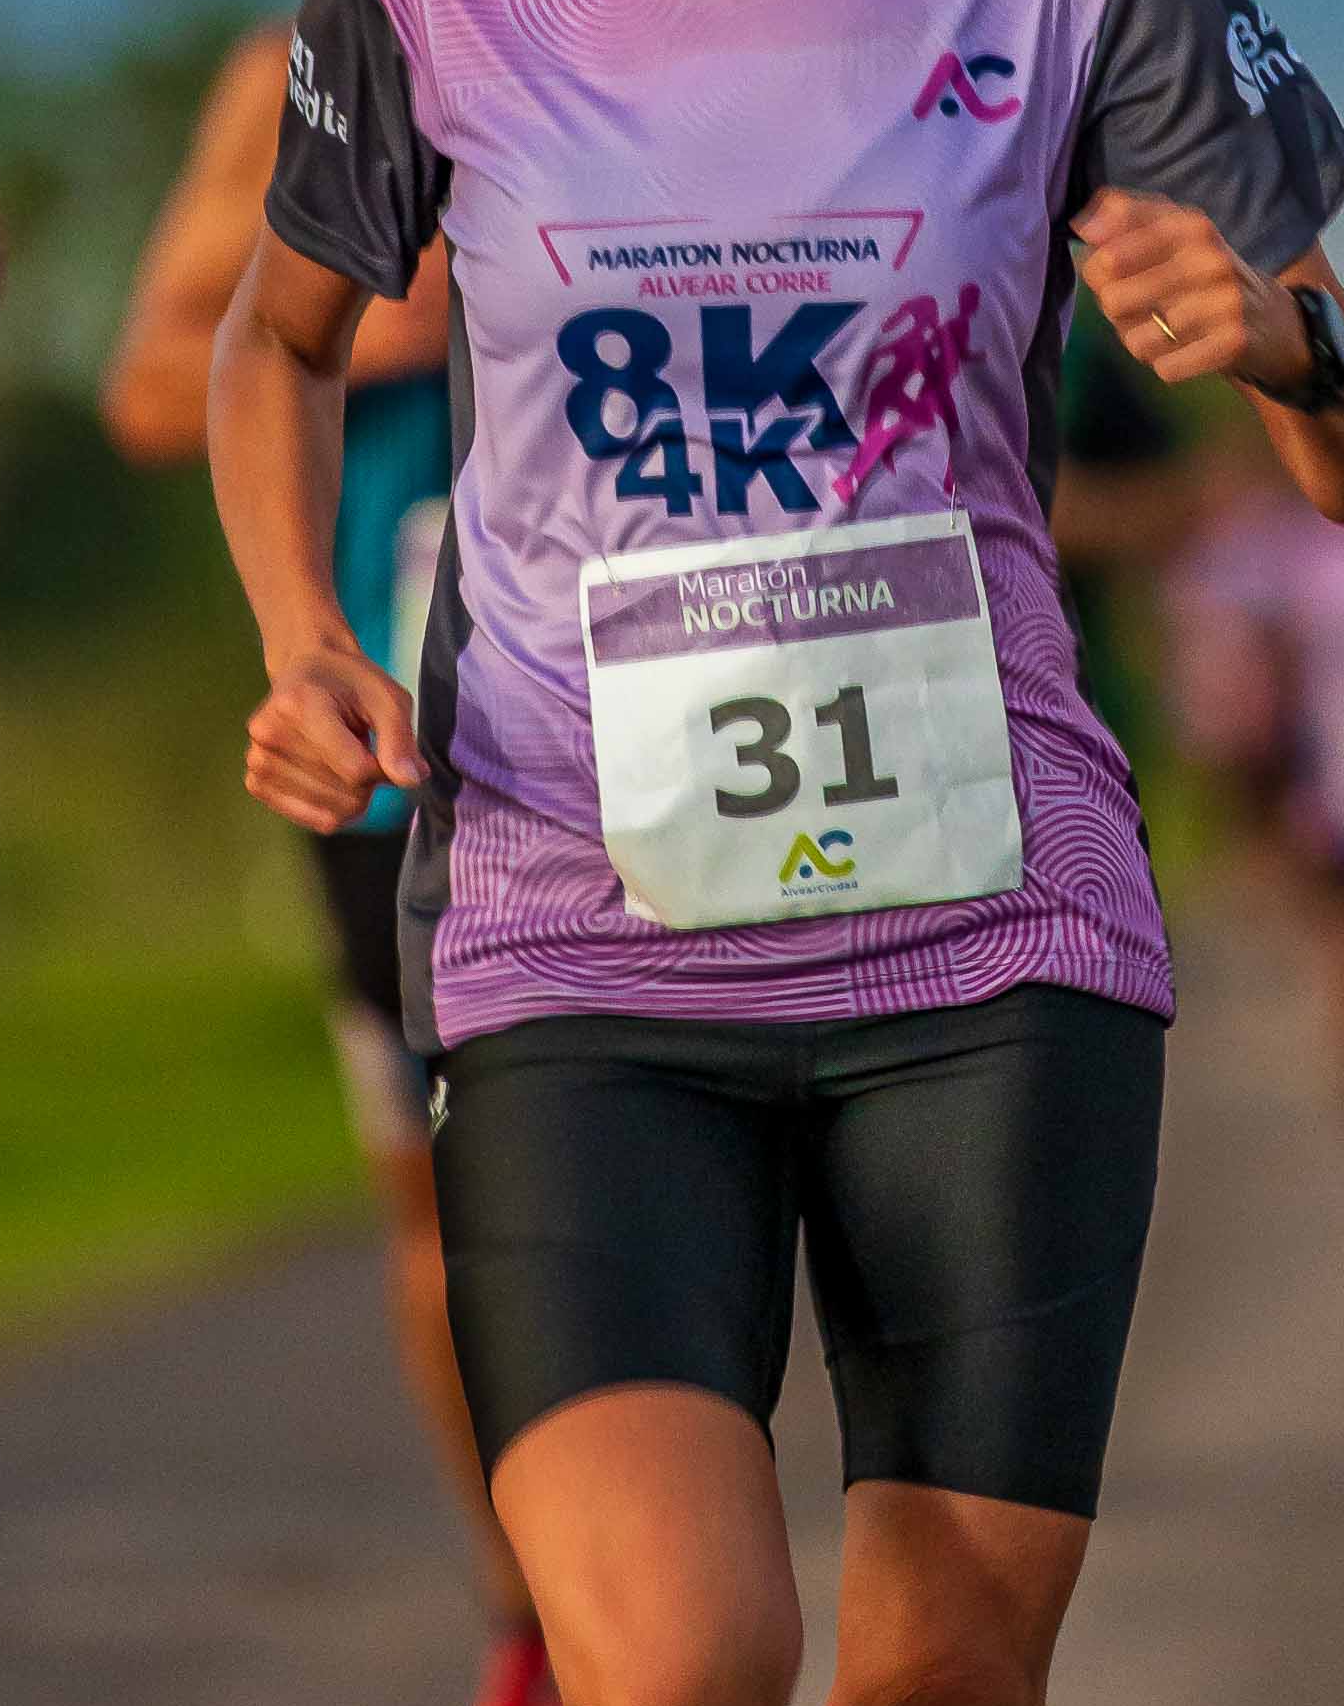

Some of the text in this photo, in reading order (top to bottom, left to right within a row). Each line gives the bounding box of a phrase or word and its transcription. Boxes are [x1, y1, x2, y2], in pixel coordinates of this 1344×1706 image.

[589, 238, 881, 270] MARATON NOCTURNA
[638, 270, 832, 298] ALVEAR CORRE
[557, 302, 868, 460] 8K
[615, 409, 823, 517] 4K
[678, 559, 808, 602] Maratón
[682, 580, 896, 636] NOCTURNA
[710, 685, 899, 819] 31
